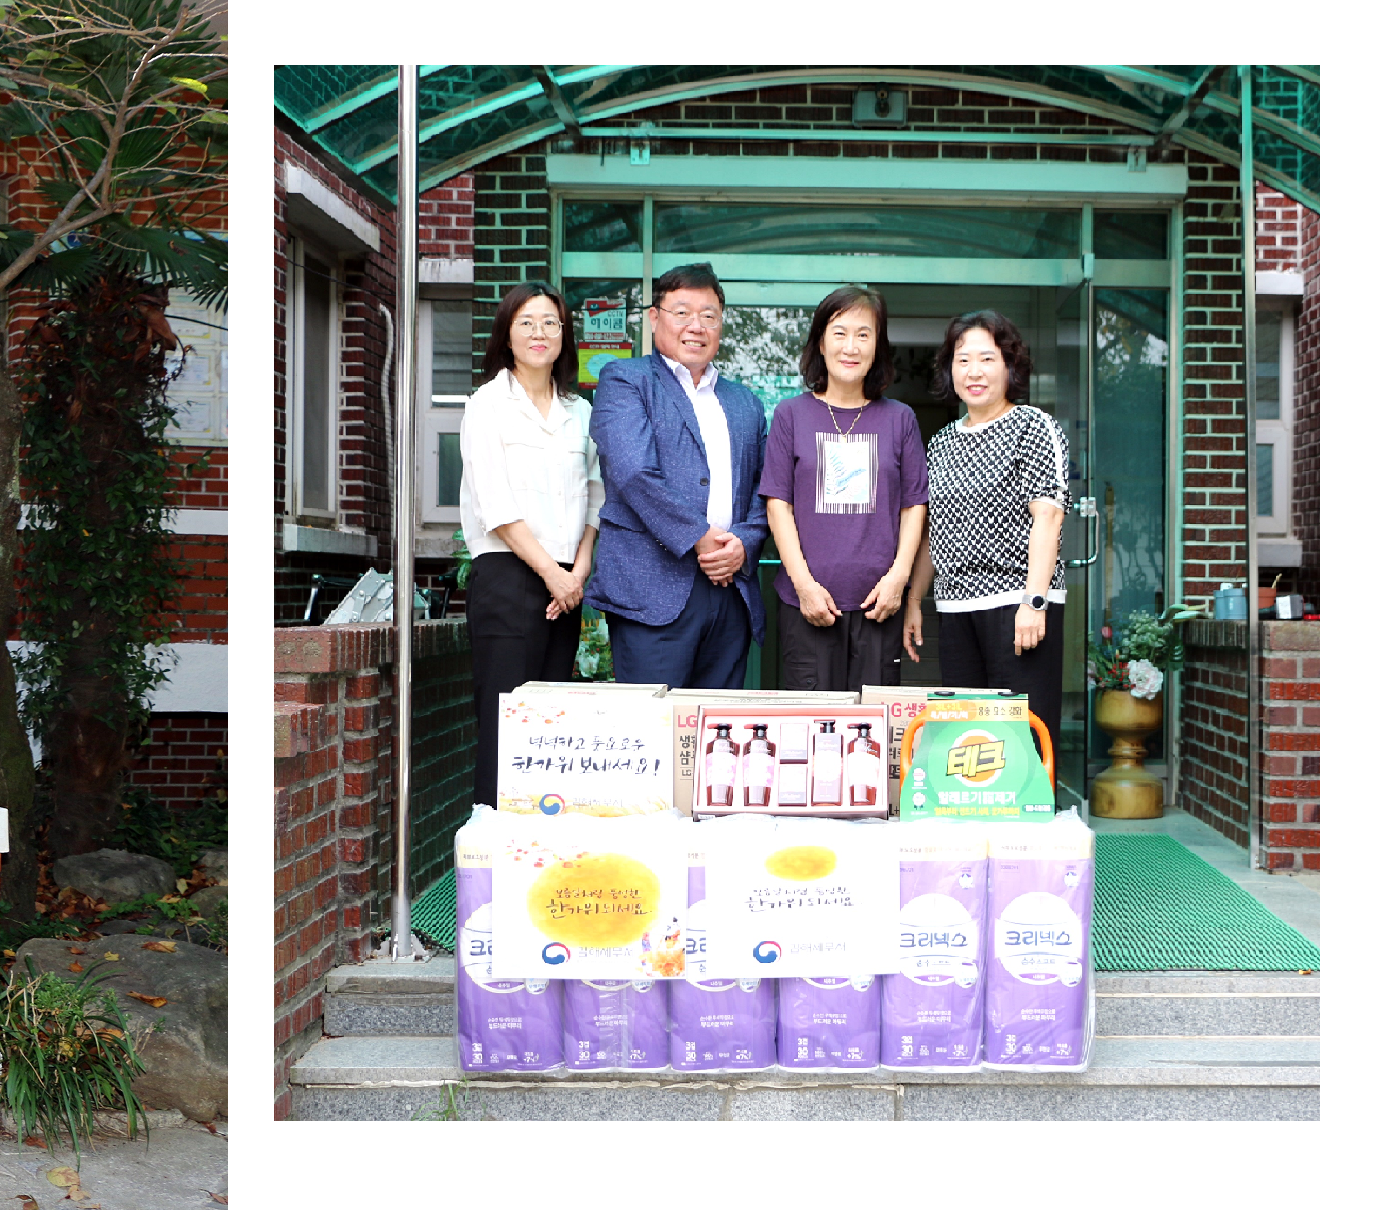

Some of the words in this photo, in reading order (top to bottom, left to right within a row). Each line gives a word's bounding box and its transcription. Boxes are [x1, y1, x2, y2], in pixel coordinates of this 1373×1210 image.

[677, 714, 697, 728] LG
[529, 735, 586, 751] 넉넉하고
[512, 756, 574, 774] 한가위
[945, 739, 1006, 778] 테크
[900, 932, 968, 948] 크리넥스
[1004, 930, 1072, 946] 크리넥스
